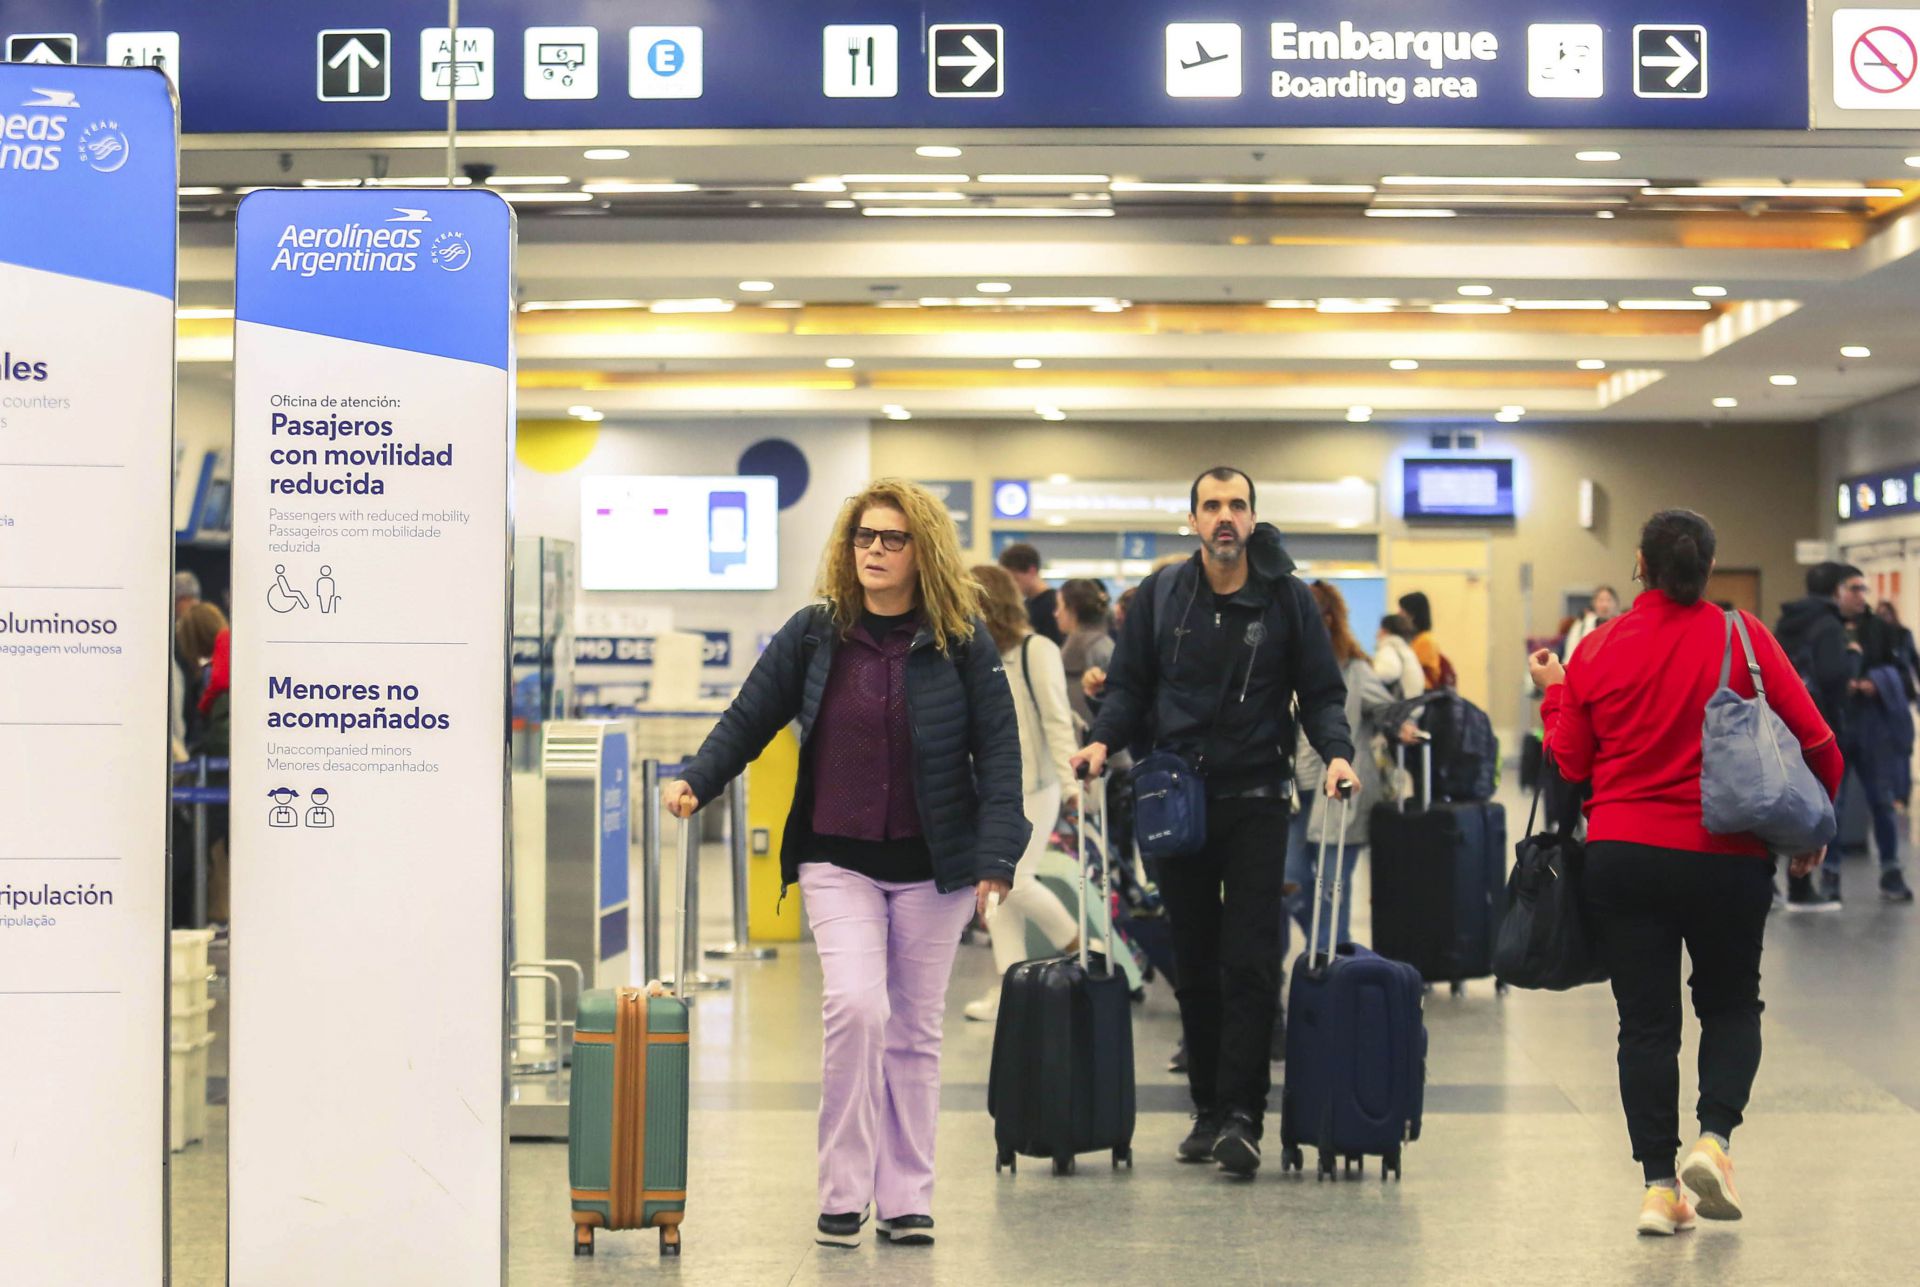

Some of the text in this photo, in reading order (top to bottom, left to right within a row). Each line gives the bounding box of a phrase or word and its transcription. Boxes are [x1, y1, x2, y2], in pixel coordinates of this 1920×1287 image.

[438, 39, 477, 53] AM
[1270, 21, 1499, 69] Embarque
[1272, 70, 1477, 104] Boarding area
[277, 223, 422, 248] Aerolíneas
[430, 231, 463, 264] SKYTEAM
[270, 248, 418, 277] Argentinas
[2, 392, 71, 409] counters
[271, 395, 400, 407] Oficina de atención:
[272, 413, 392, 441] Pasajeros
[270, 443, 452, 466] con movilidad
[271, 472, 384, 495] reducida
[269, 508, 470, 524] Passengers with reduced mobility
[269, 524, 441, 539] Passageiros com mobilidade
[268, 541, 321, 552] reduzida
[64, 643, 122, 654] volumosa
[269, 677, 418, 700] Menores no
[268, 707, 449, 733] acompañados
[267, 743, 411, 758] Unaccompanied minors
[267, 758, 438, 774] Menores desacompanhados
